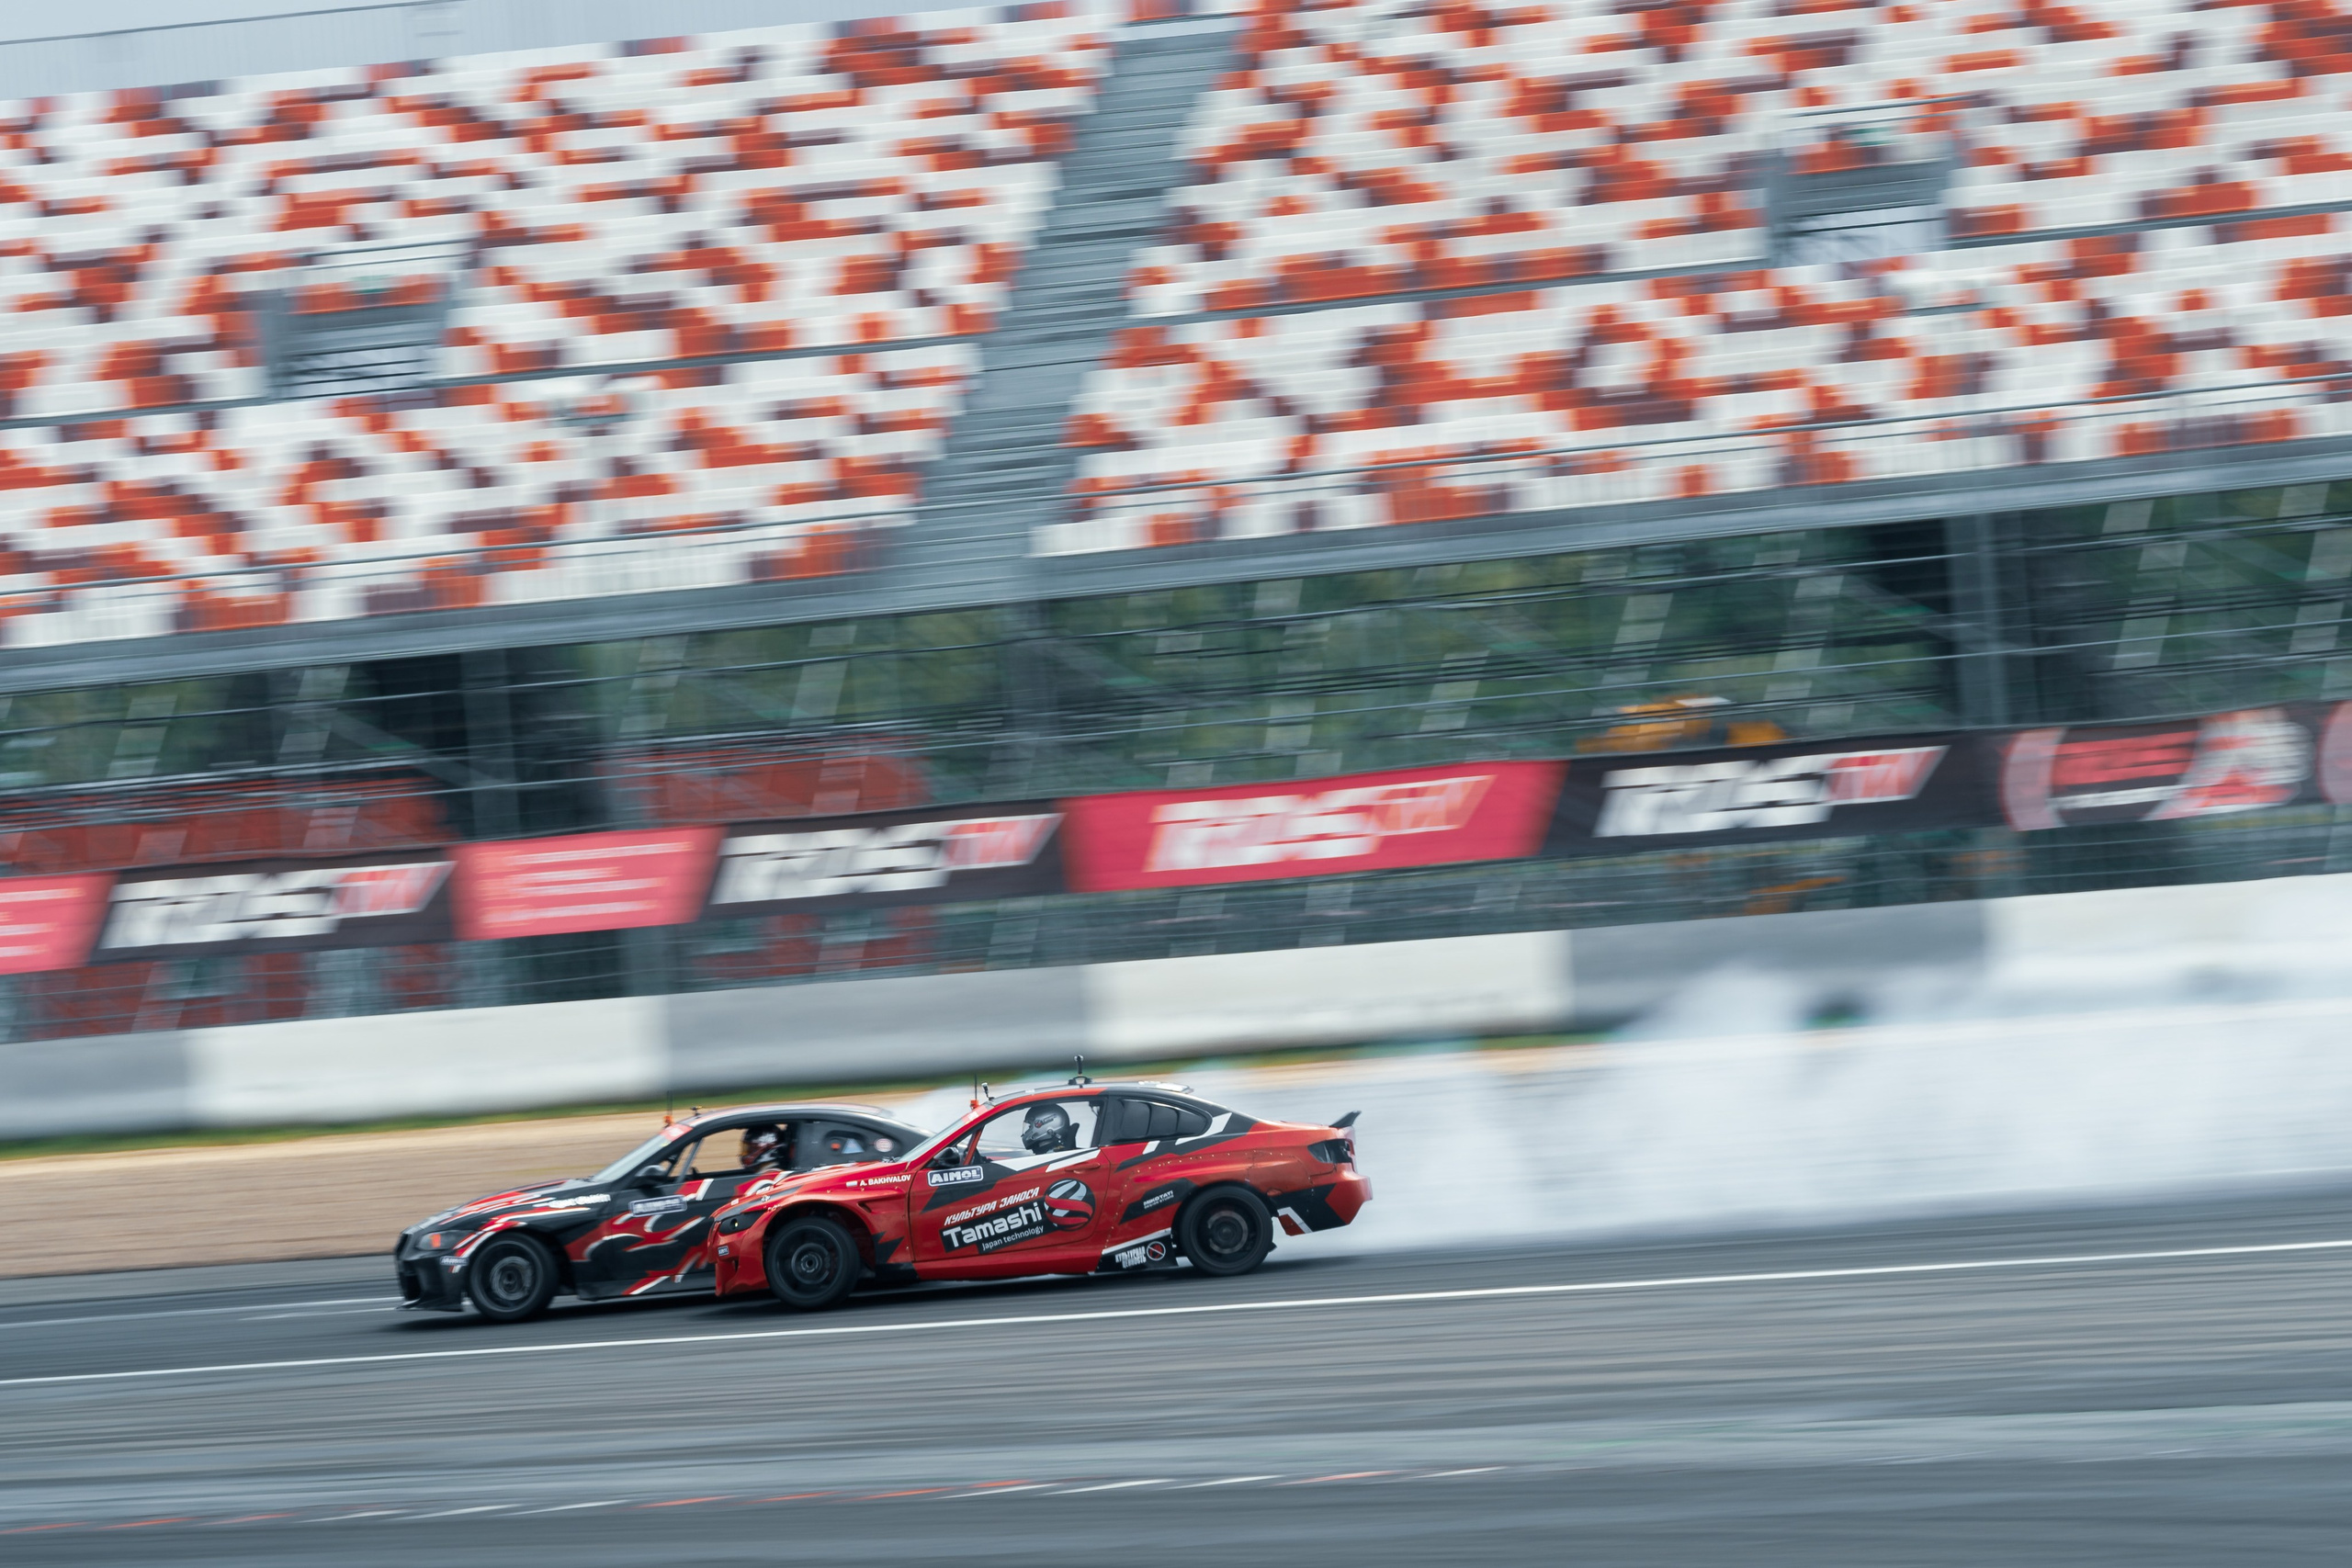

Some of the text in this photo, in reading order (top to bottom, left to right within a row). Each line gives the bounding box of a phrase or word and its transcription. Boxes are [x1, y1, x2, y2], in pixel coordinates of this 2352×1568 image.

[868, 1175, 911, 1186] BAKHVALOV
[931, 1169, 980, 1184] AIMOL
[944, 1187, 1040, 1226] КУЛЬТУРА ЗАНОСА
[943, 1201, 1043, 1247] Tamashi
[982, 1224, 1044, 1251] Japan technology
